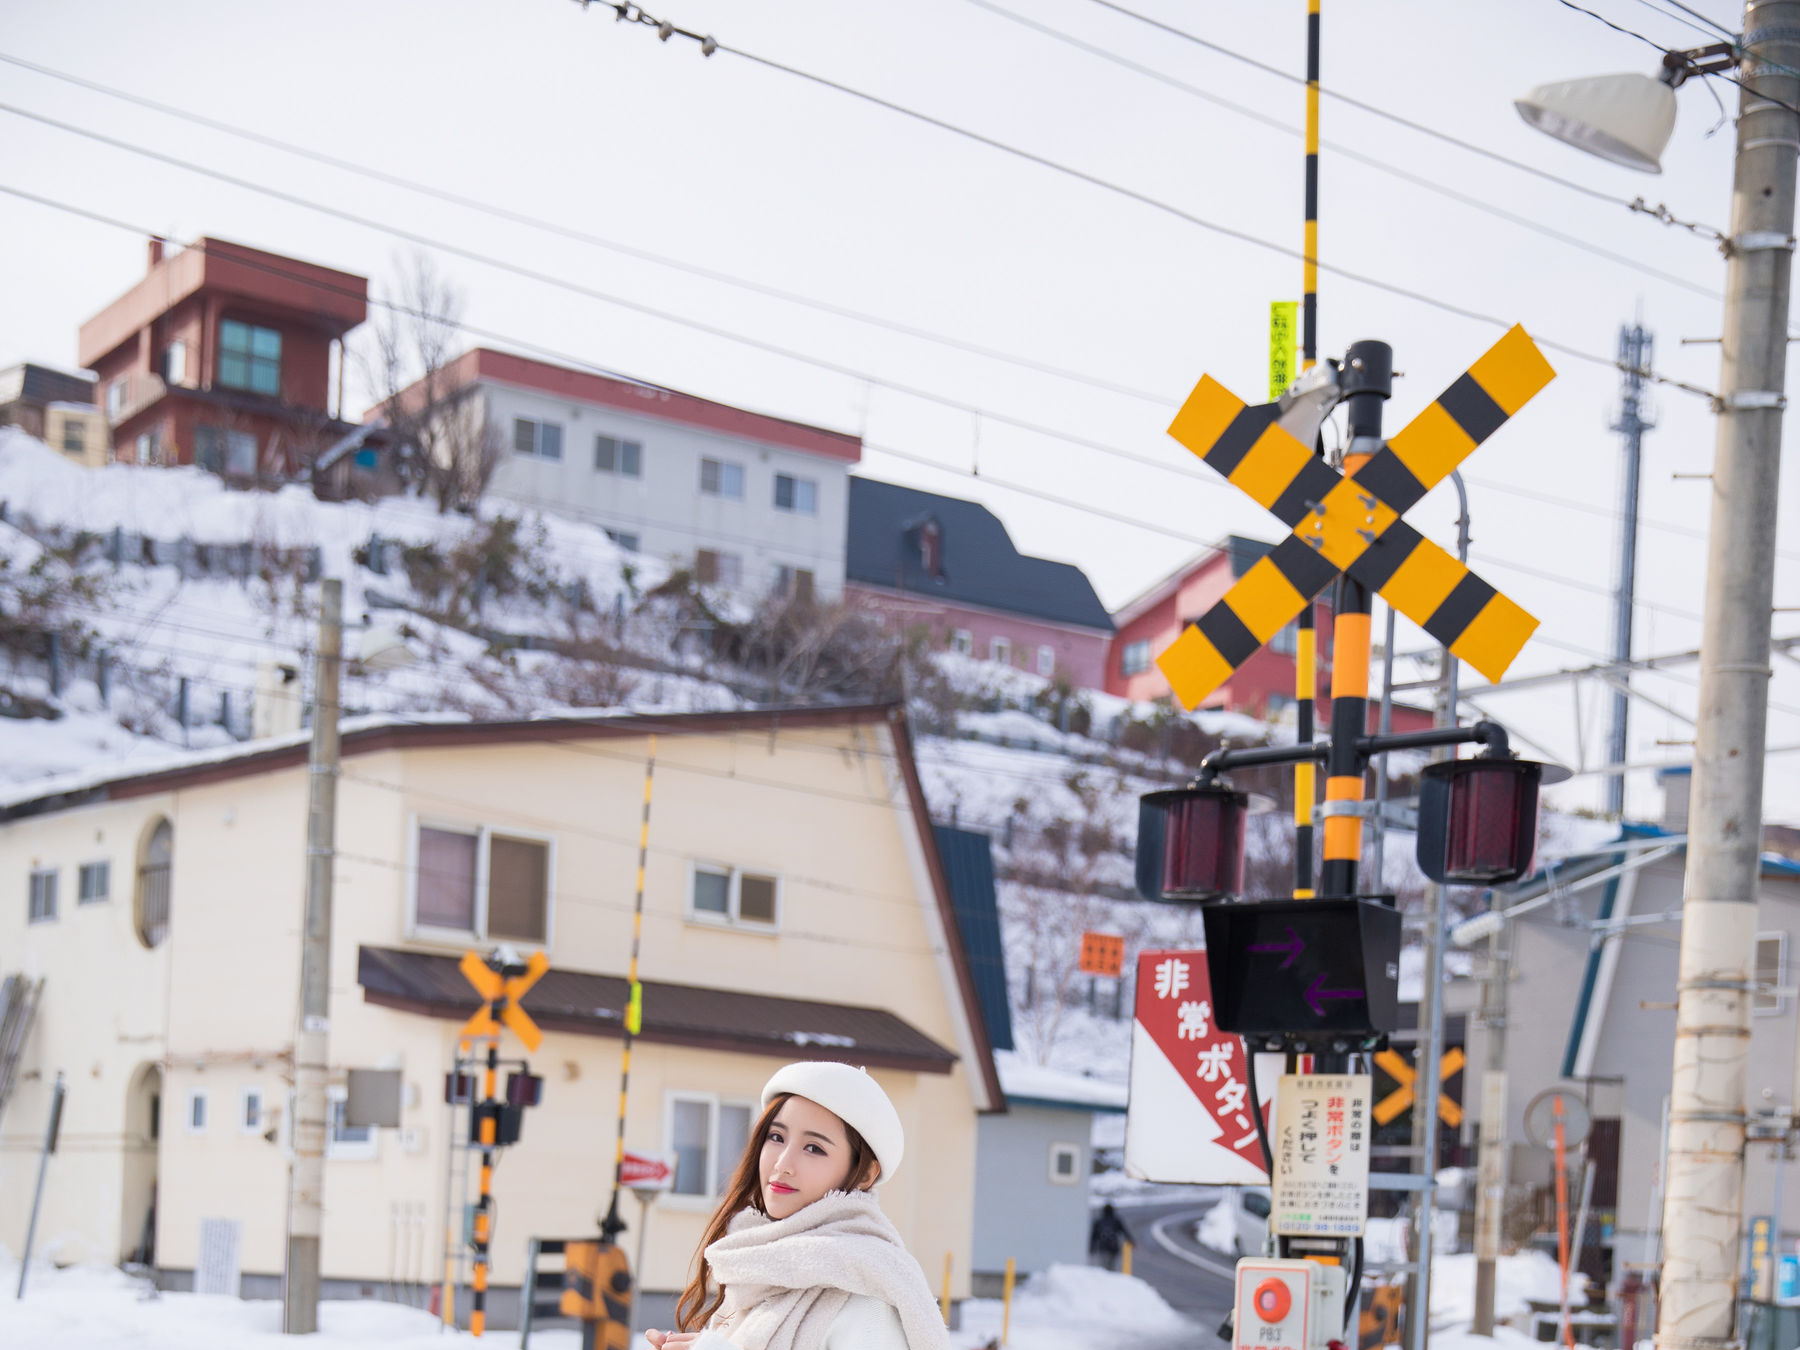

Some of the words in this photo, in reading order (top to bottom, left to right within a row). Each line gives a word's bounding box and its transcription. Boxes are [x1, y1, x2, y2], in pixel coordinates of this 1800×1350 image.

[1154, 958, 1259, 1150] 非常ボタン
